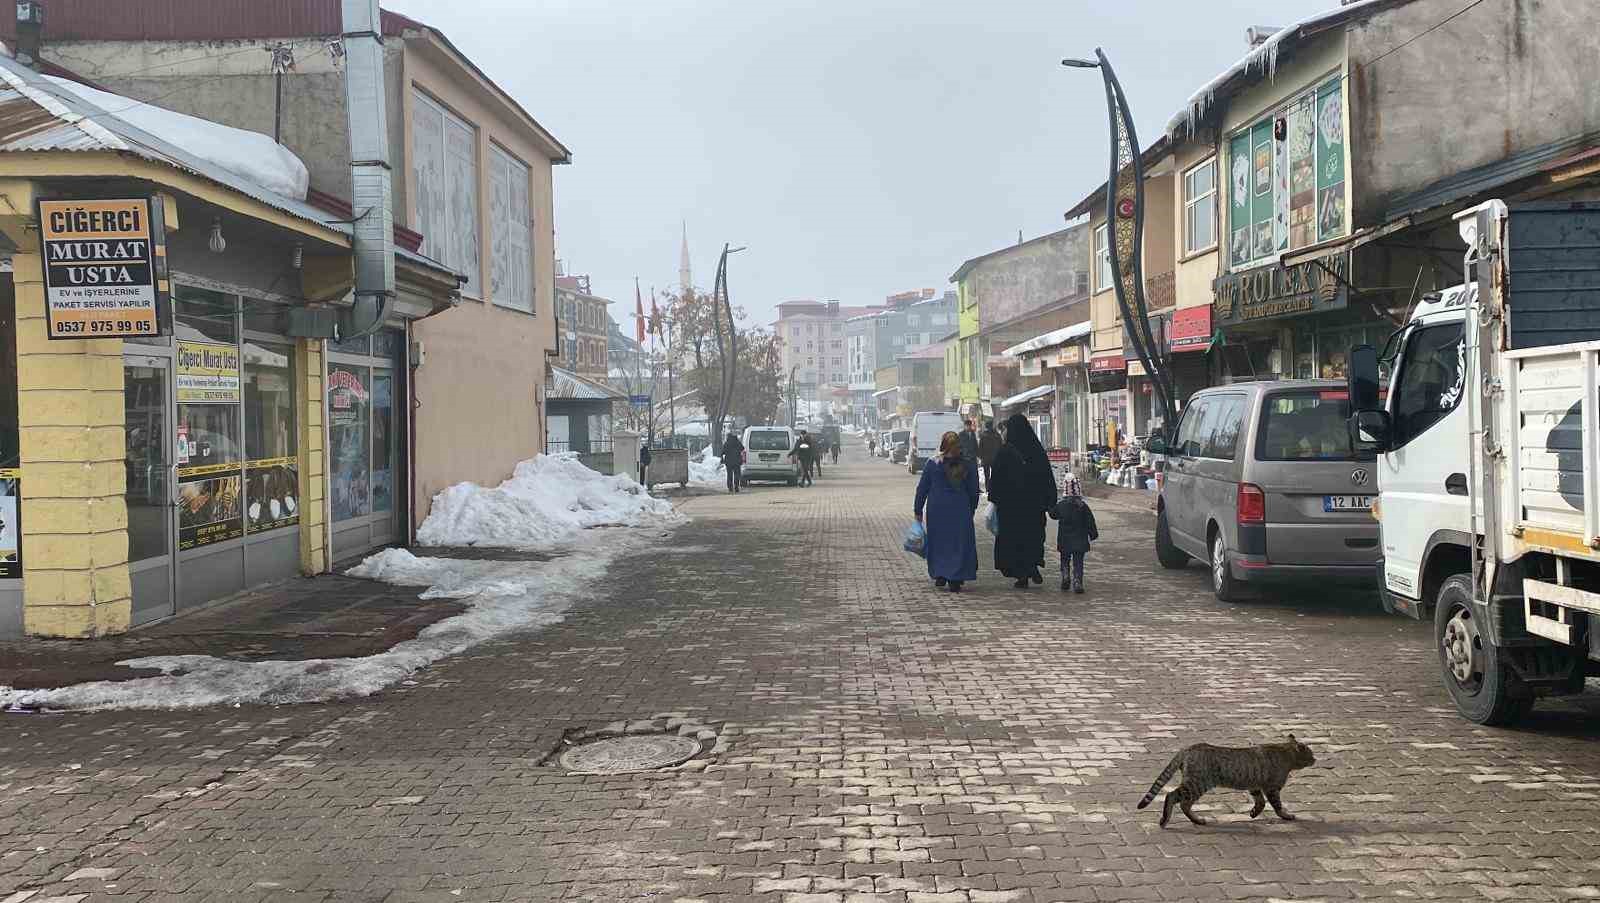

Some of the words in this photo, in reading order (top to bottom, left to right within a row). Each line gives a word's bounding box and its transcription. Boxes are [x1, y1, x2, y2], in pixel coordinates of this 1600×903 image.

[50, 206, 140, 233] CİĞERCİ
[50, 241, 145, 260] MURAT
[67, 266, 134, 284] USTA
[1240, 263, 1314, 305] ROLEX
[59, 289, 71, 297] EV
[84, 287, 141, 298] İŞYERLERİNE
[53, 301, 81, 309] PAKET
[83, 300, 117, 308] SERVİSİ
[57, 321, 86, 333] 0537
[90, 321, 113, 332] 975
[117, 321, 132, 332] 99
[135, 320, 151, 332] 05
[203, 350, 223, 369] Murat
[223, 351, 237, 369] Usta
[1332, 496, 1344, 508] 12
